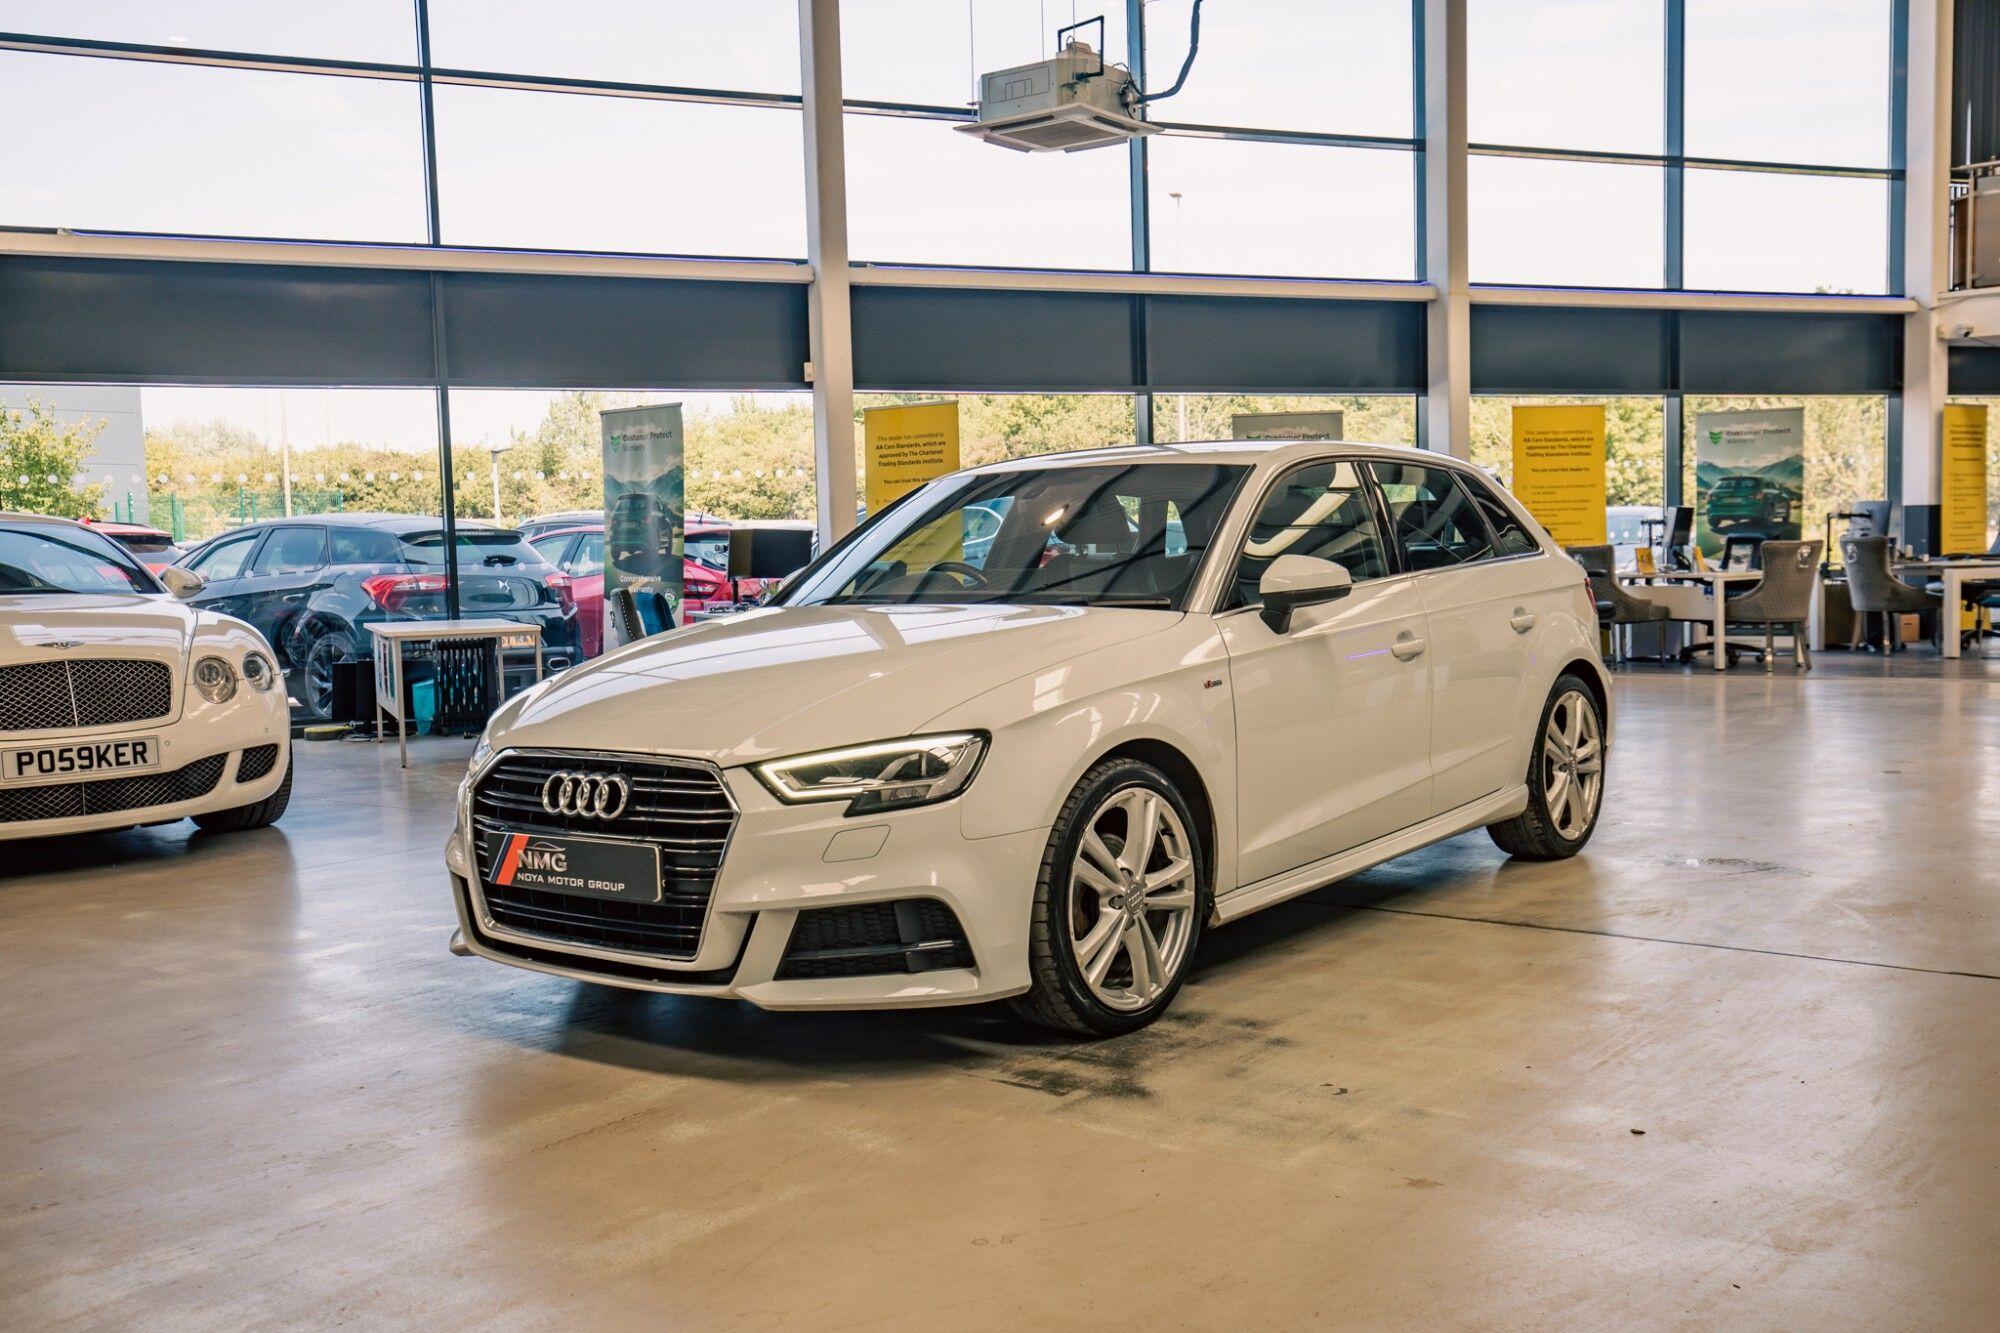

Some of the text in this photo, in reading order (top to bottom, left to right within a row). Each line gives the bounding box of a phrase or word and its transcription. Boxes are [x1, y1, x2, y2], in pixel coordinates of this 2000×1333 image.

[650, 430, 672, 439] Protect
[517, 849, 567, 872] NMG
[517, 872, 625, 892] NOYA MOTOR GROUP
